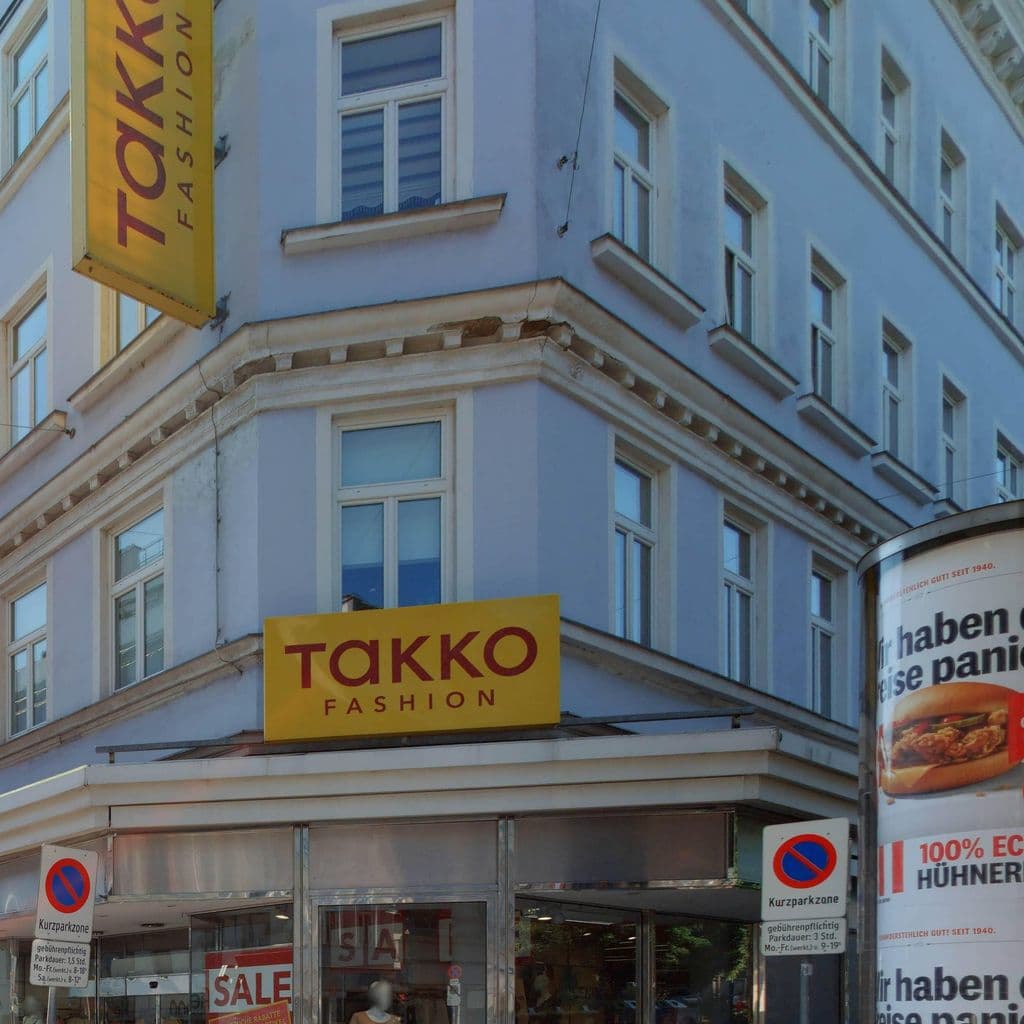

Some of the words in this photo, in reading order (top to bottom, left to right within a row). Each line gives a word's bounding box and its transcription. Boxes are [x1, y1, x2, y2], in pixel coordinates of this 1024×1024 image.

[176, 12, 193, 230] FASHION
[952, 567, 969, 579] SEIT
[972, 562, 996, 574] 1940.
[897, 607, 1009, 660] haben
[324, 688, 496, 716] FASHION
[919, 837, 985, 864] 100%
[917, 860, 1024, 890] HÜHNER
[769, 895, 839, 908] Kurzparkzone
[39, 919, 90, 933] Kurzparkzone
[767, 920, 840, 934] gebührenpflichtig
[952, 928, 970, 936] SEIT
[973, 926, 996, 936] 1940.
[768, 934, 812, 943] Parkdauer:
[813, 932, 819, 941] 3
[821, 932, 837, 941] Std.
[37, 944, 87, 957] gebührenpflichtig
[214, 970, 292, 1007] SALE
[896, 966, 1009, 1002] haben
